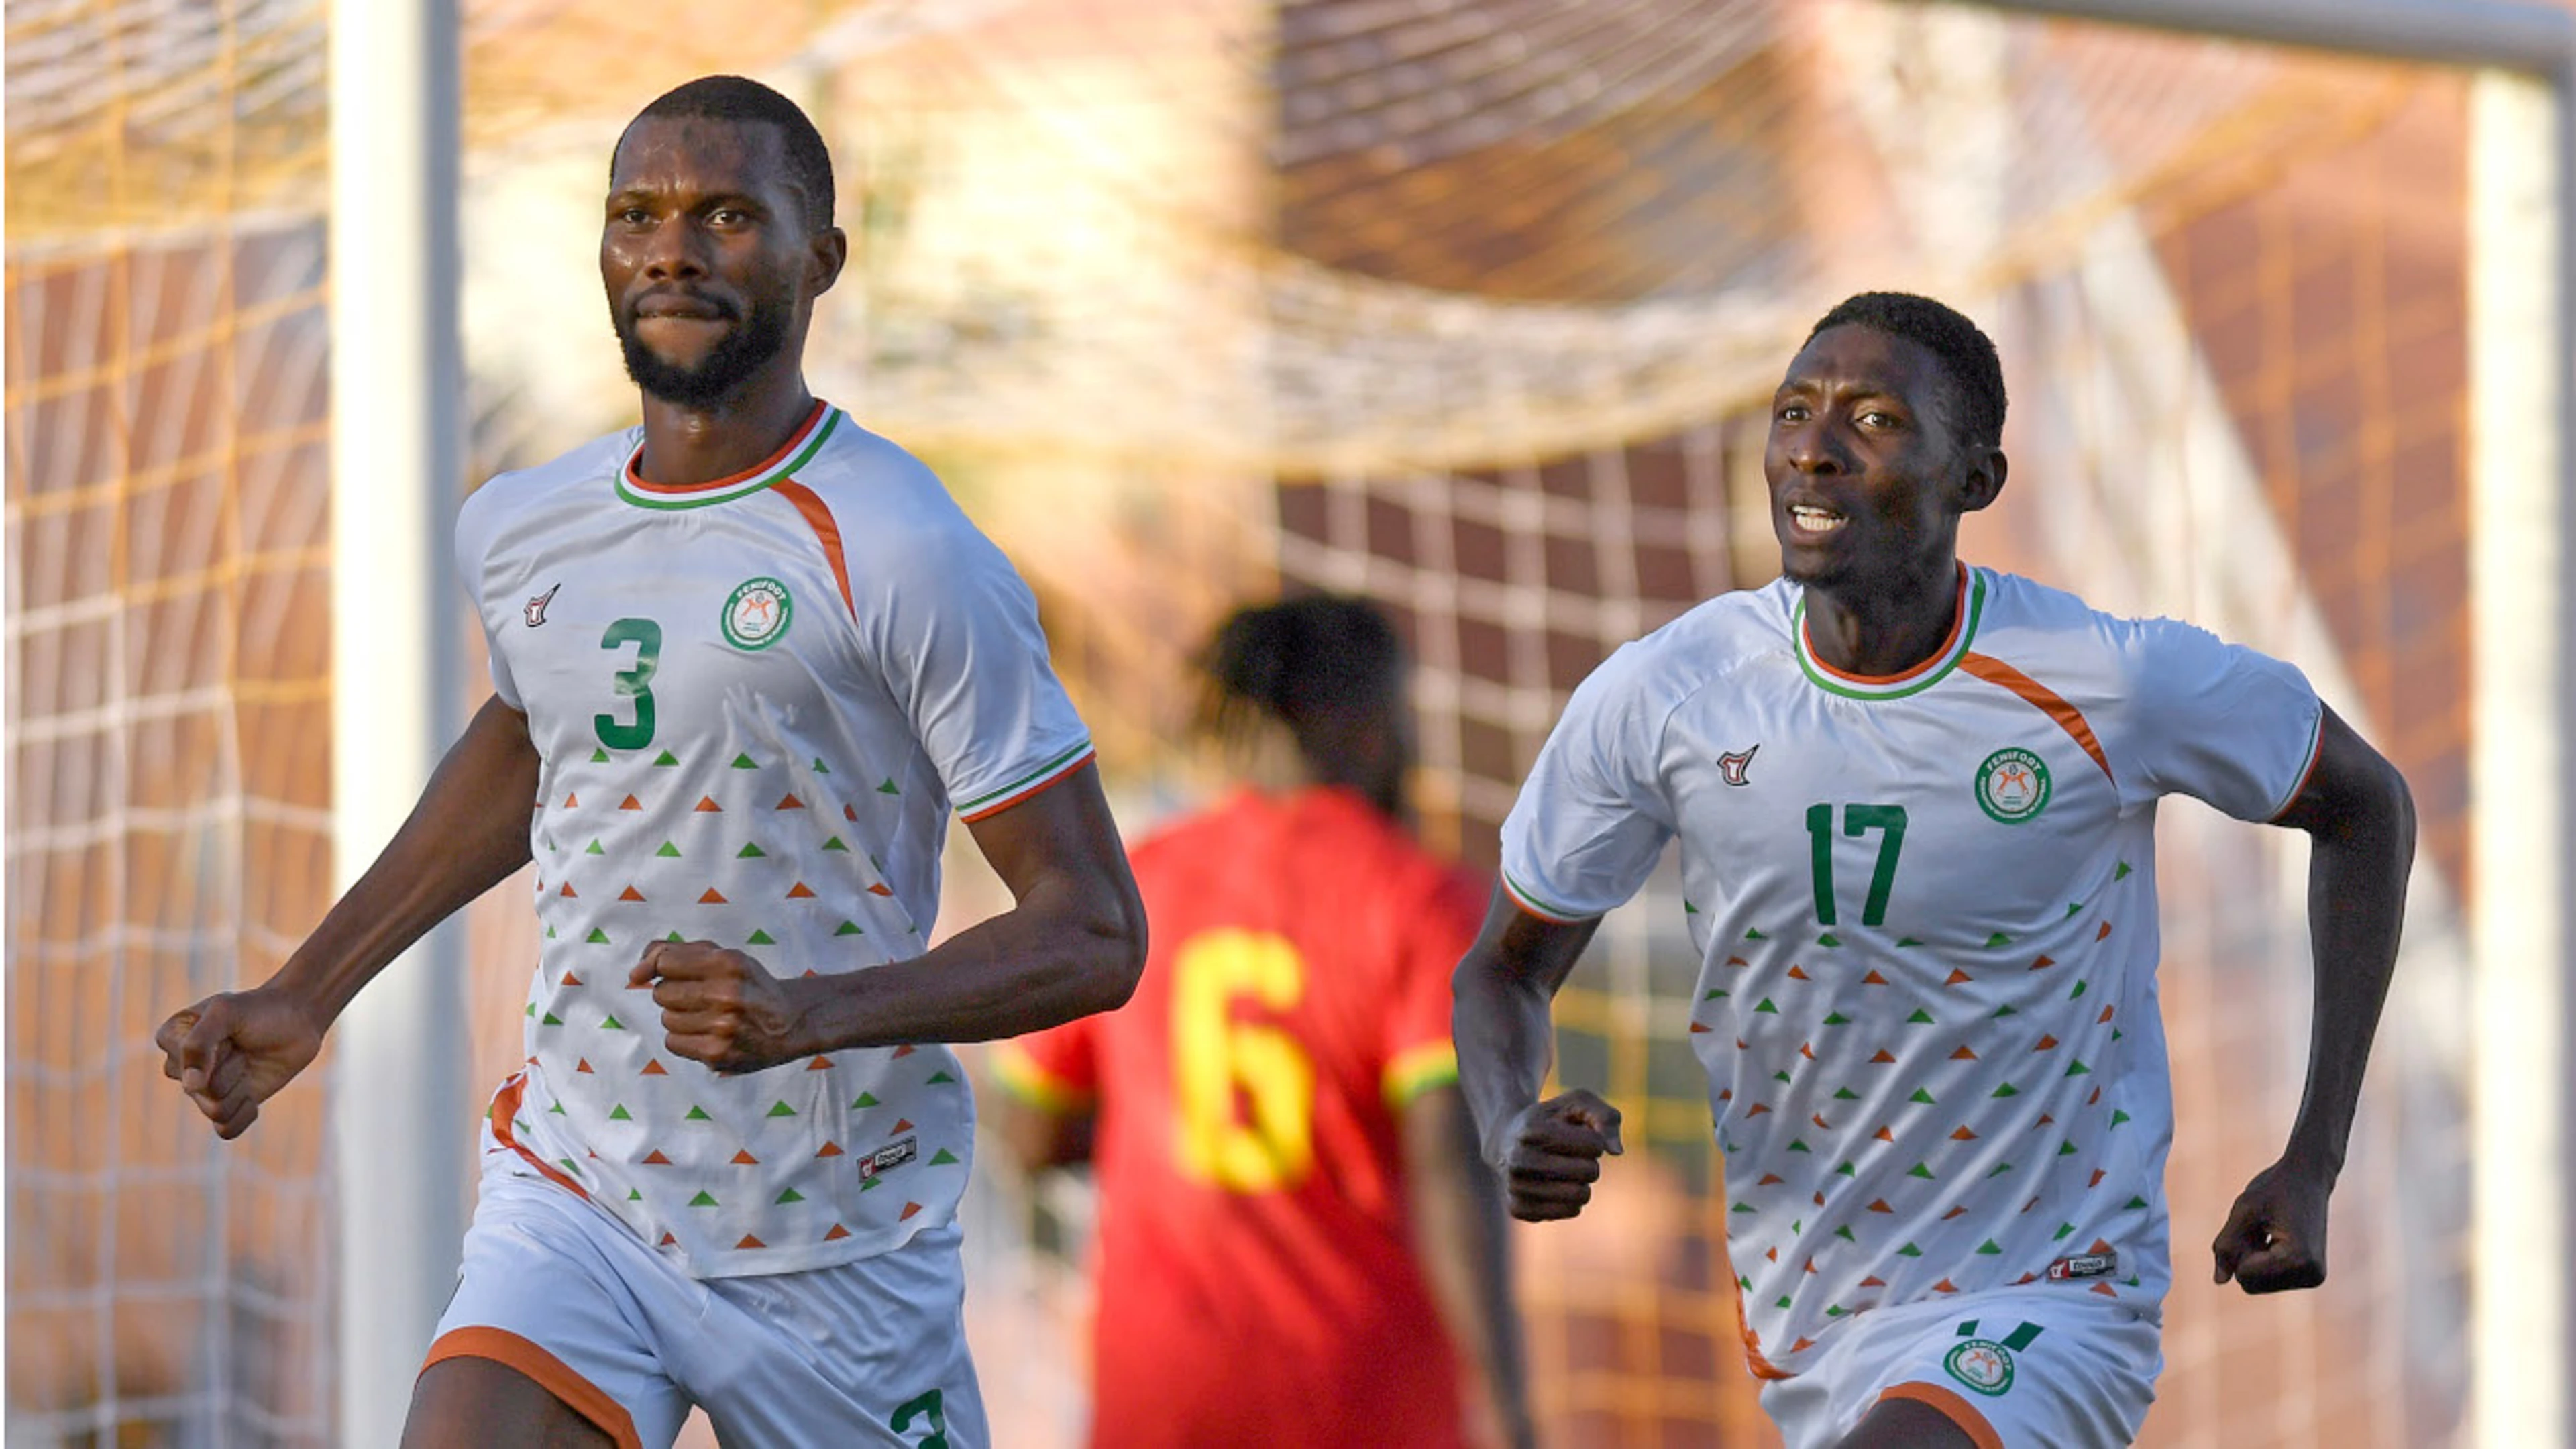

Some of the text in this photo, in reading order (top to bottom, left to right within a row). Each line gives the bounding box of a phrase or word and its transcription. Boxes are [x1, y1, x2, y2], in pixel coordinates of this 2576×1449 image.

[736, 581, 787, 600] FENIFOOT
[594, 618, 661, 749] 3
[1986, 751, 2042, 771] FENIFOOT
[1806, 802, 1908, 926] 17
[1173, 928, 1312, 1193] 6
